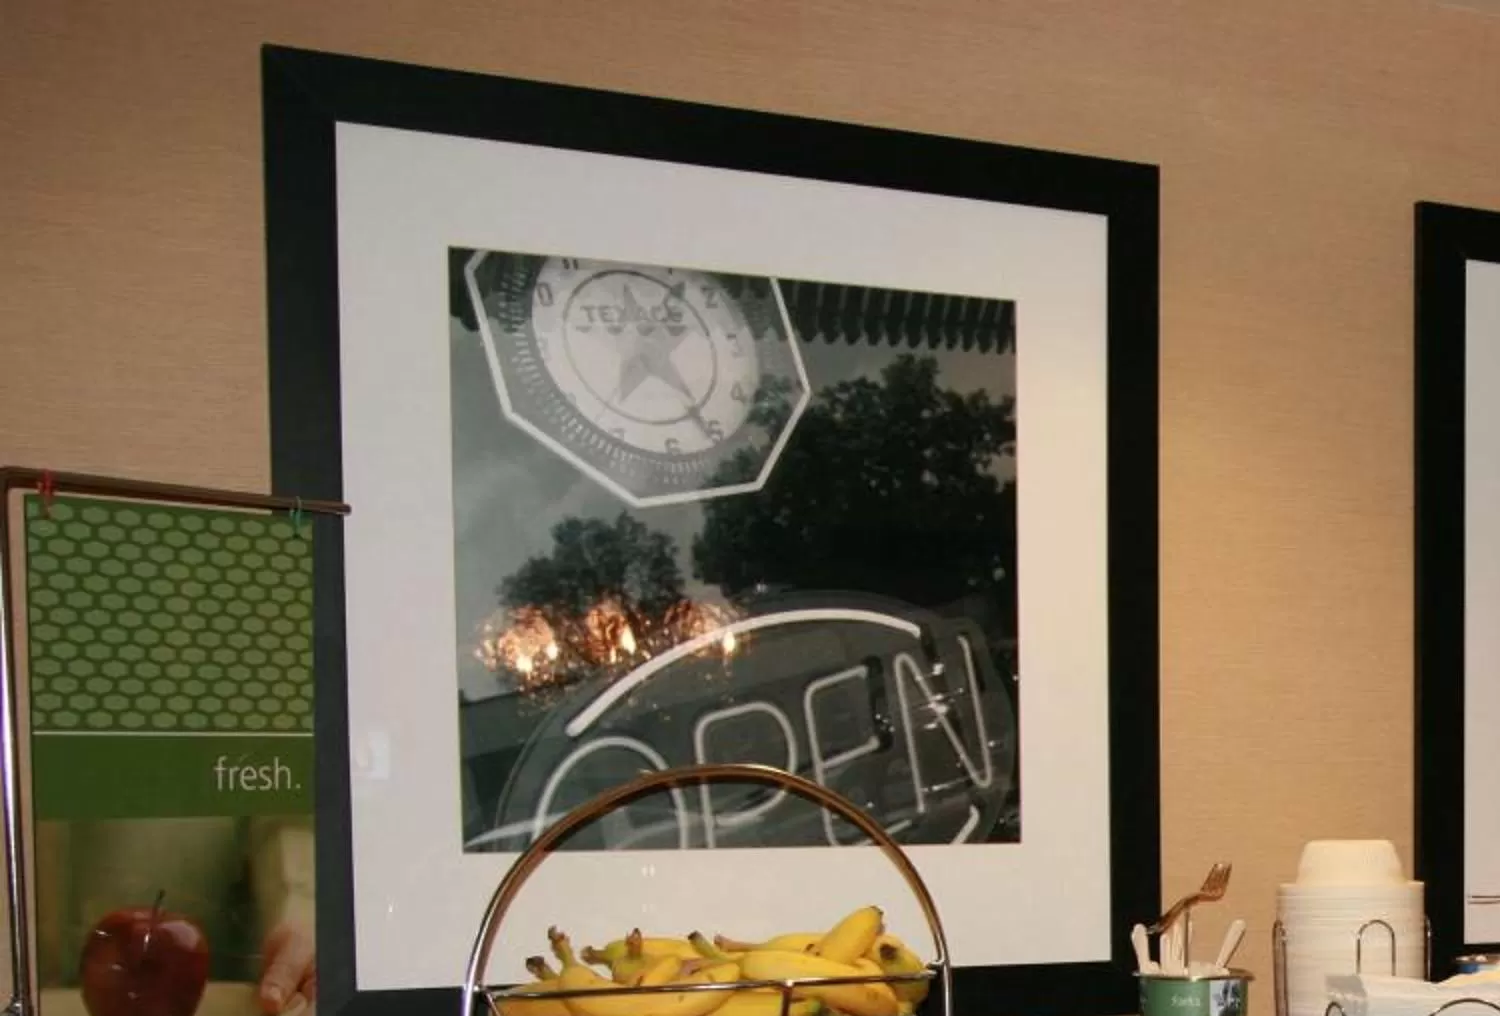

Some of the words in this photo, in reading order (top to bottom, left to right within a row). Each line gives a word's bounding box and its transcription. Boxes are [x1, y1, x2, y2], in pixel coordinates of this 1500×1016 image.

[578, 303, 686, 324] TEXACO
[531, 634, 994, 848] OPEN
[213, 755, 302, 792] fresh.
